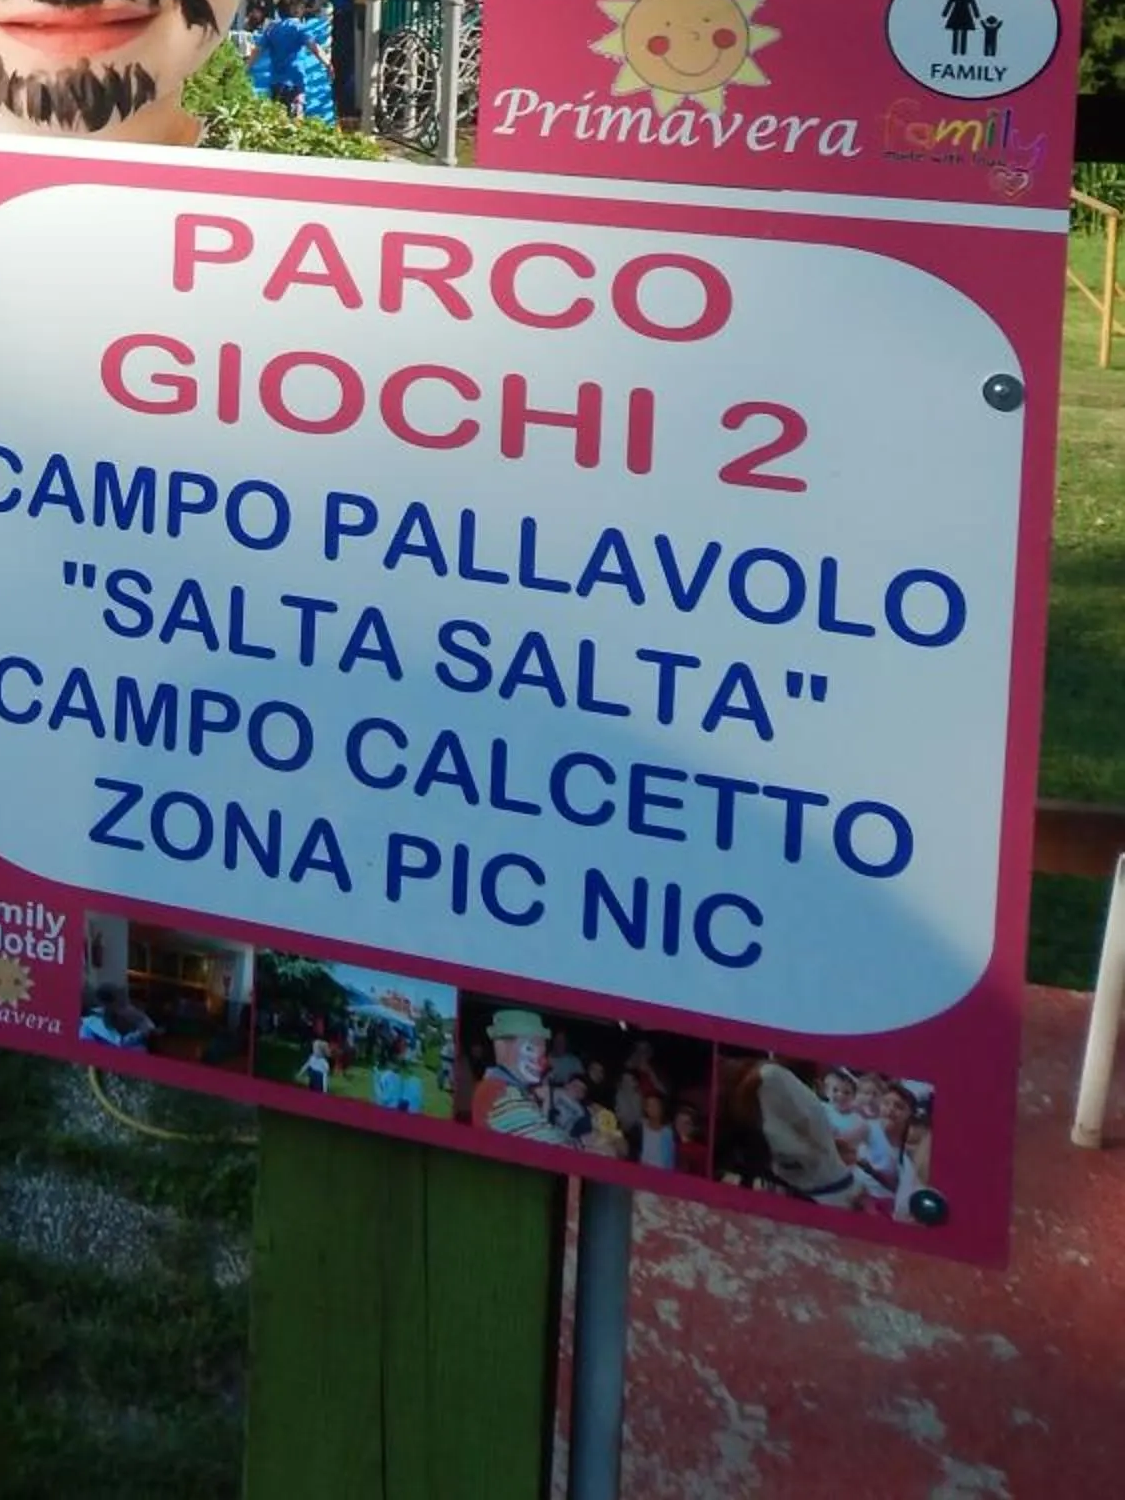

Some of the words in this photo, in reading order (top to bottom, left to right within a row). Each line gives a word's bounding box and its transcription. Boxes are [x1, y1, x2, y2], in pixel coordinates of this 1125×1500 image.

[492, 87, 862, 158] Primavera
[930, 62, 1008, 82] FAMILY
[172, 212, 733, 342] PARCO
[101, 332, 655, 474] GIOCHI
[720, 401, 808, 493] 2
[324, 491, 967, 648] PALLAVOLO
[62, 560, 405, 683] "SALTA
[435, 619, 828, 742] SALTA"
[87, 776, 354, 895] ZONA
[384, 831, 547, 928] PIC
[580, 866, 765, 970] NIC
[344, 716, 914, 879] CALCETTO
